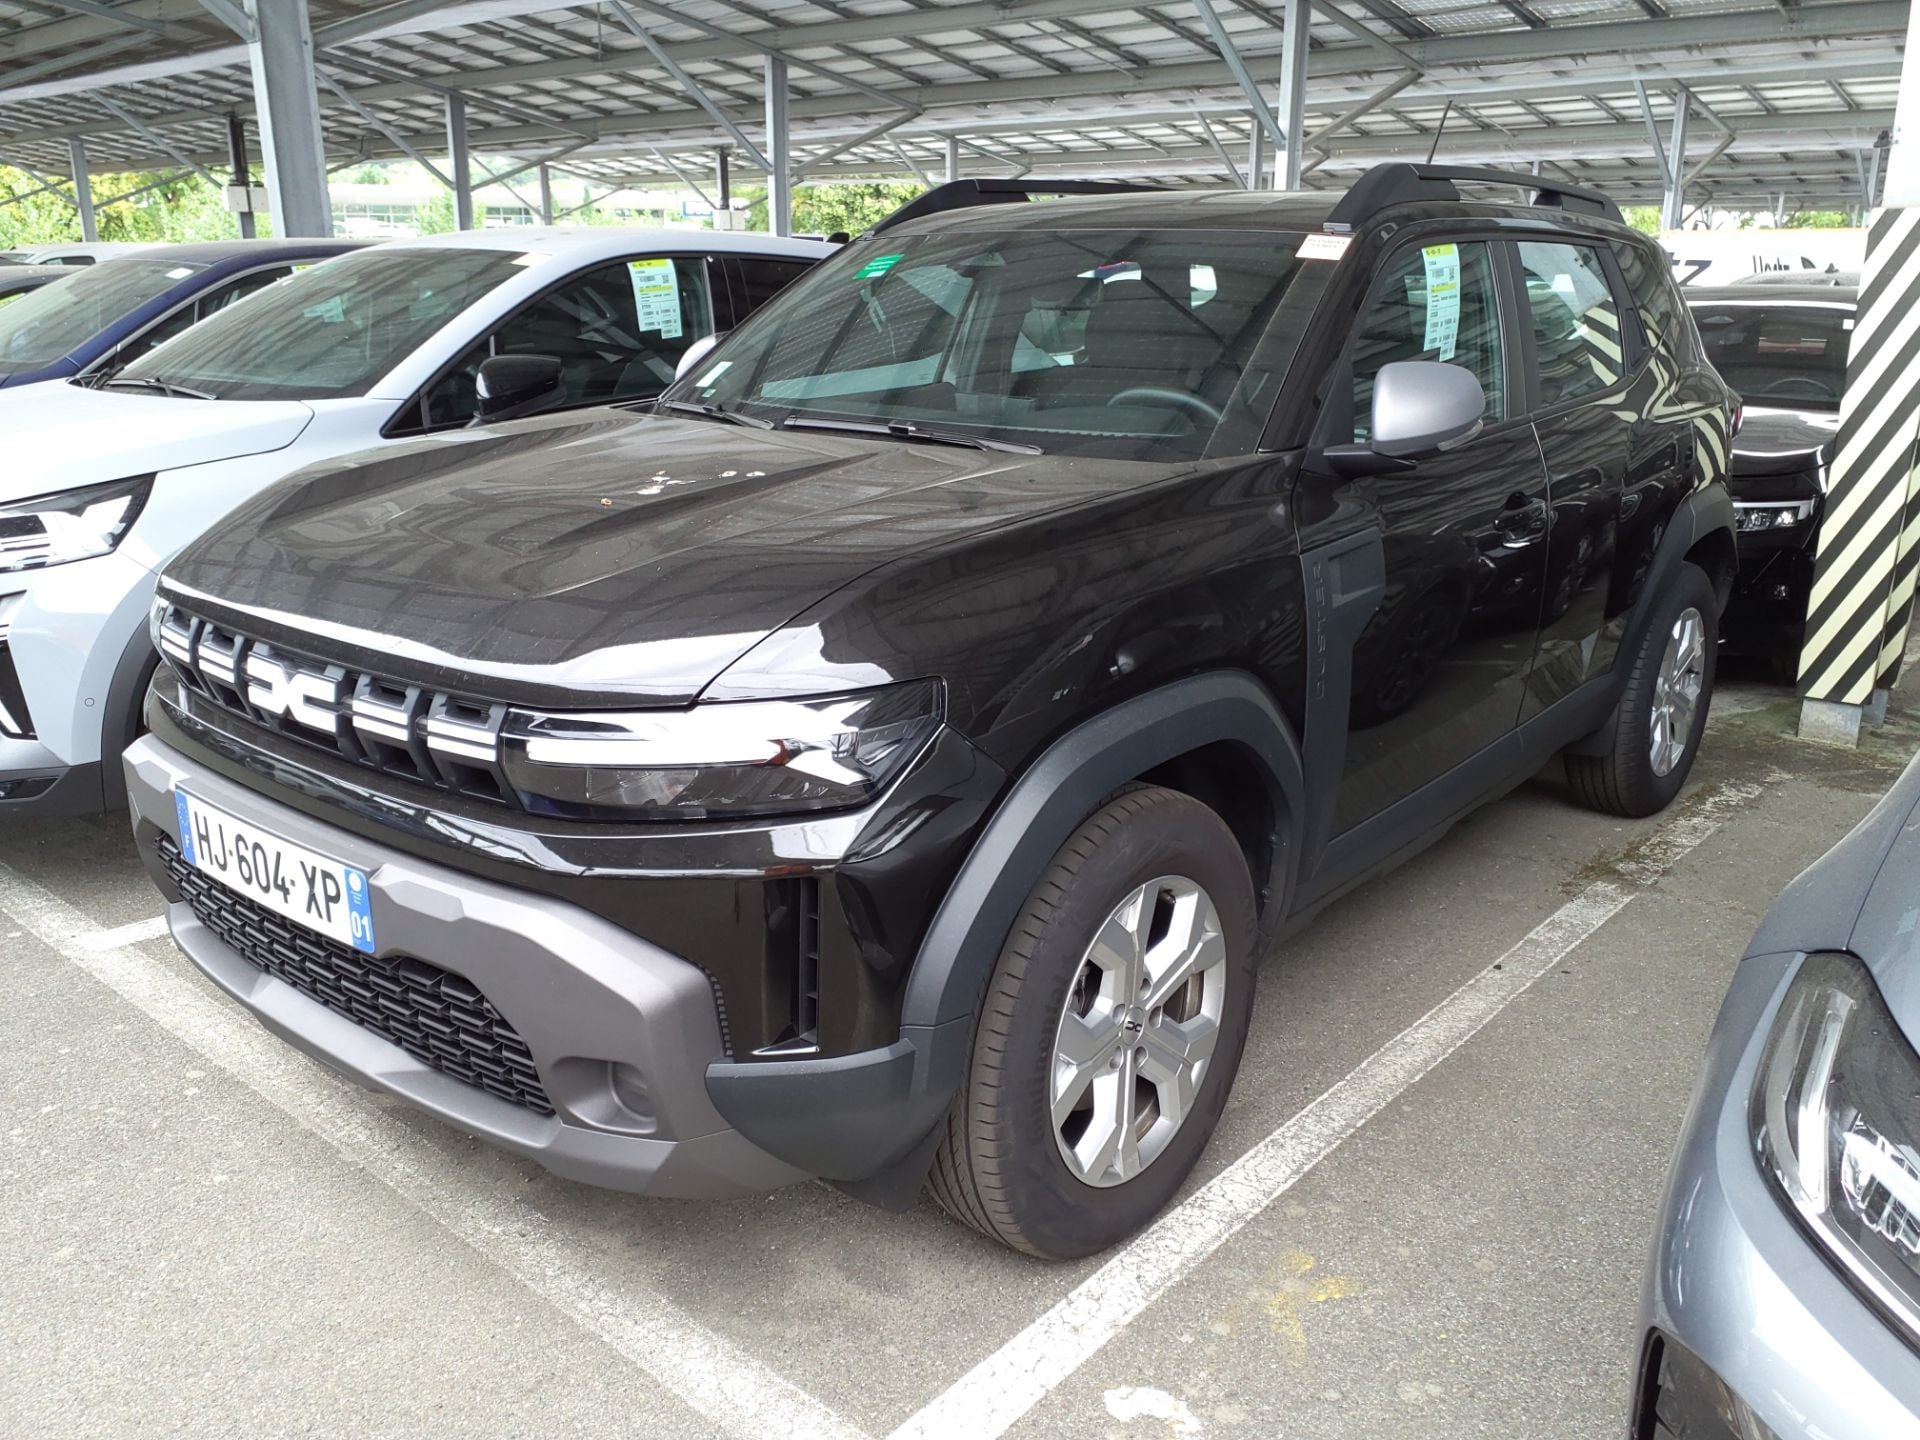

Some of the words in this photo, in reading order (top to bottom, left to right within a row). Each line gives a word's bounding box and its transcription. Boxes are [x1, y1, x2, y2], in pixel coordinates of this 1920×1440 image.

[1312, 562, 1327, 700] DUSTER
[194, 811, 341, 923] HJ-604-XP
[350, 911, 372, 943] 01
